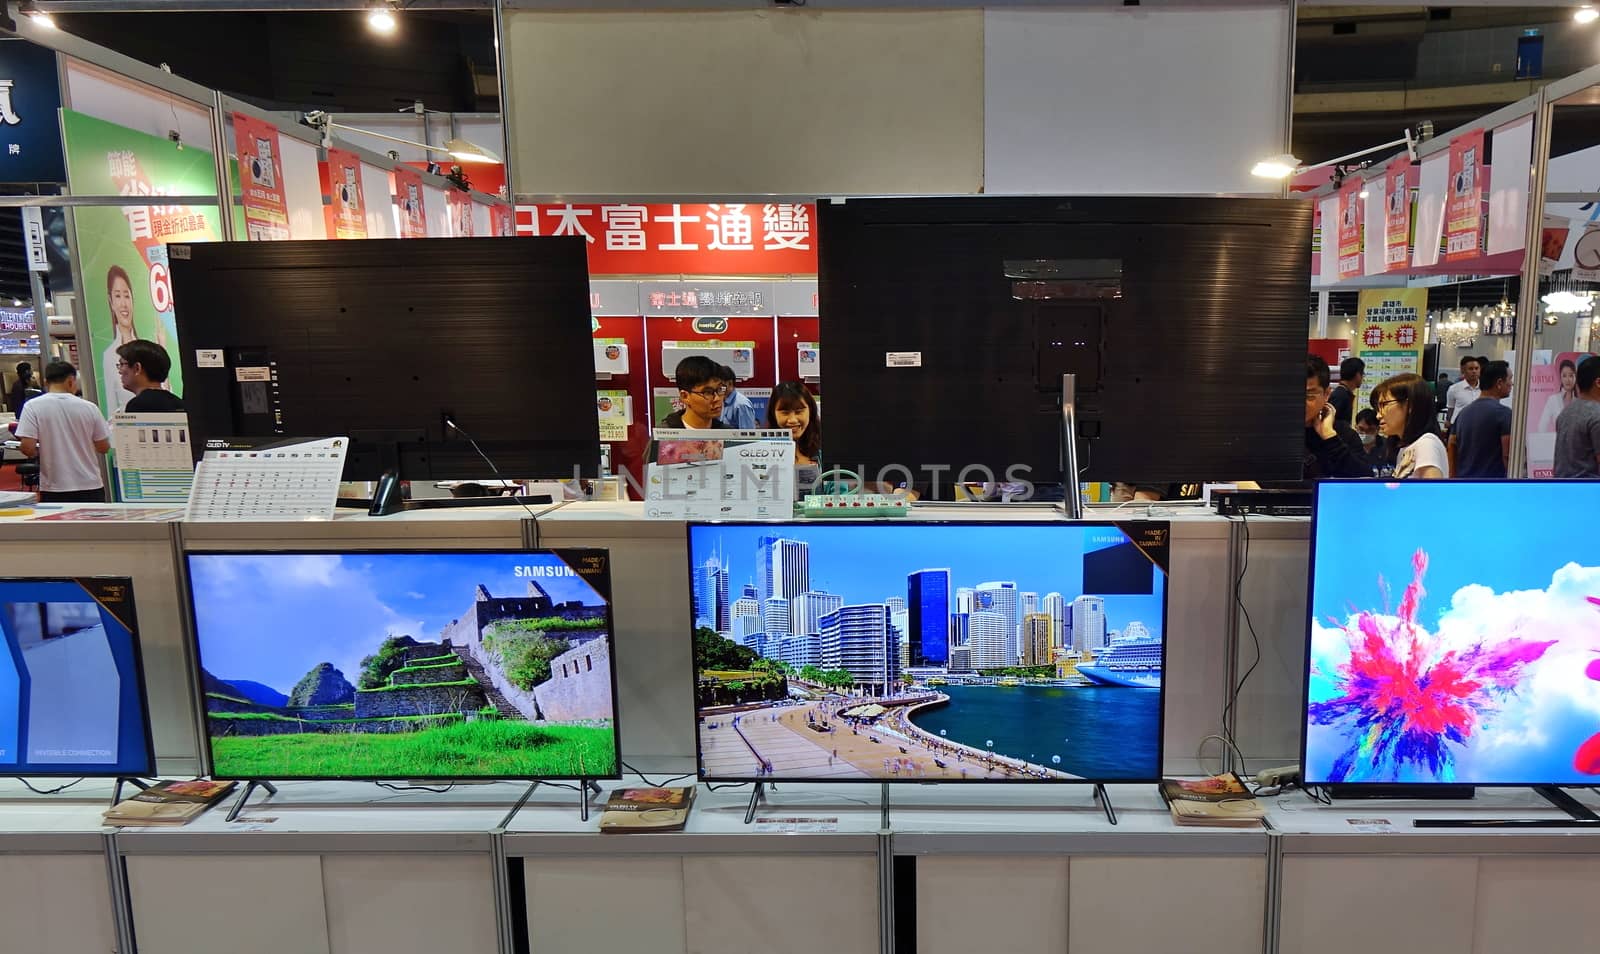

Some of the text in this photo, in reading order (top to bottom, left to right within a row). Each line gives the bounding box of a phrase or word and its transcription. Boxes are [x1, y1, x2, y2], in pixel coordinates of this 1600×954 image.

[739, 449, 785, 458] QLED TV
[514, 565, 577, 577] SAMSUN
